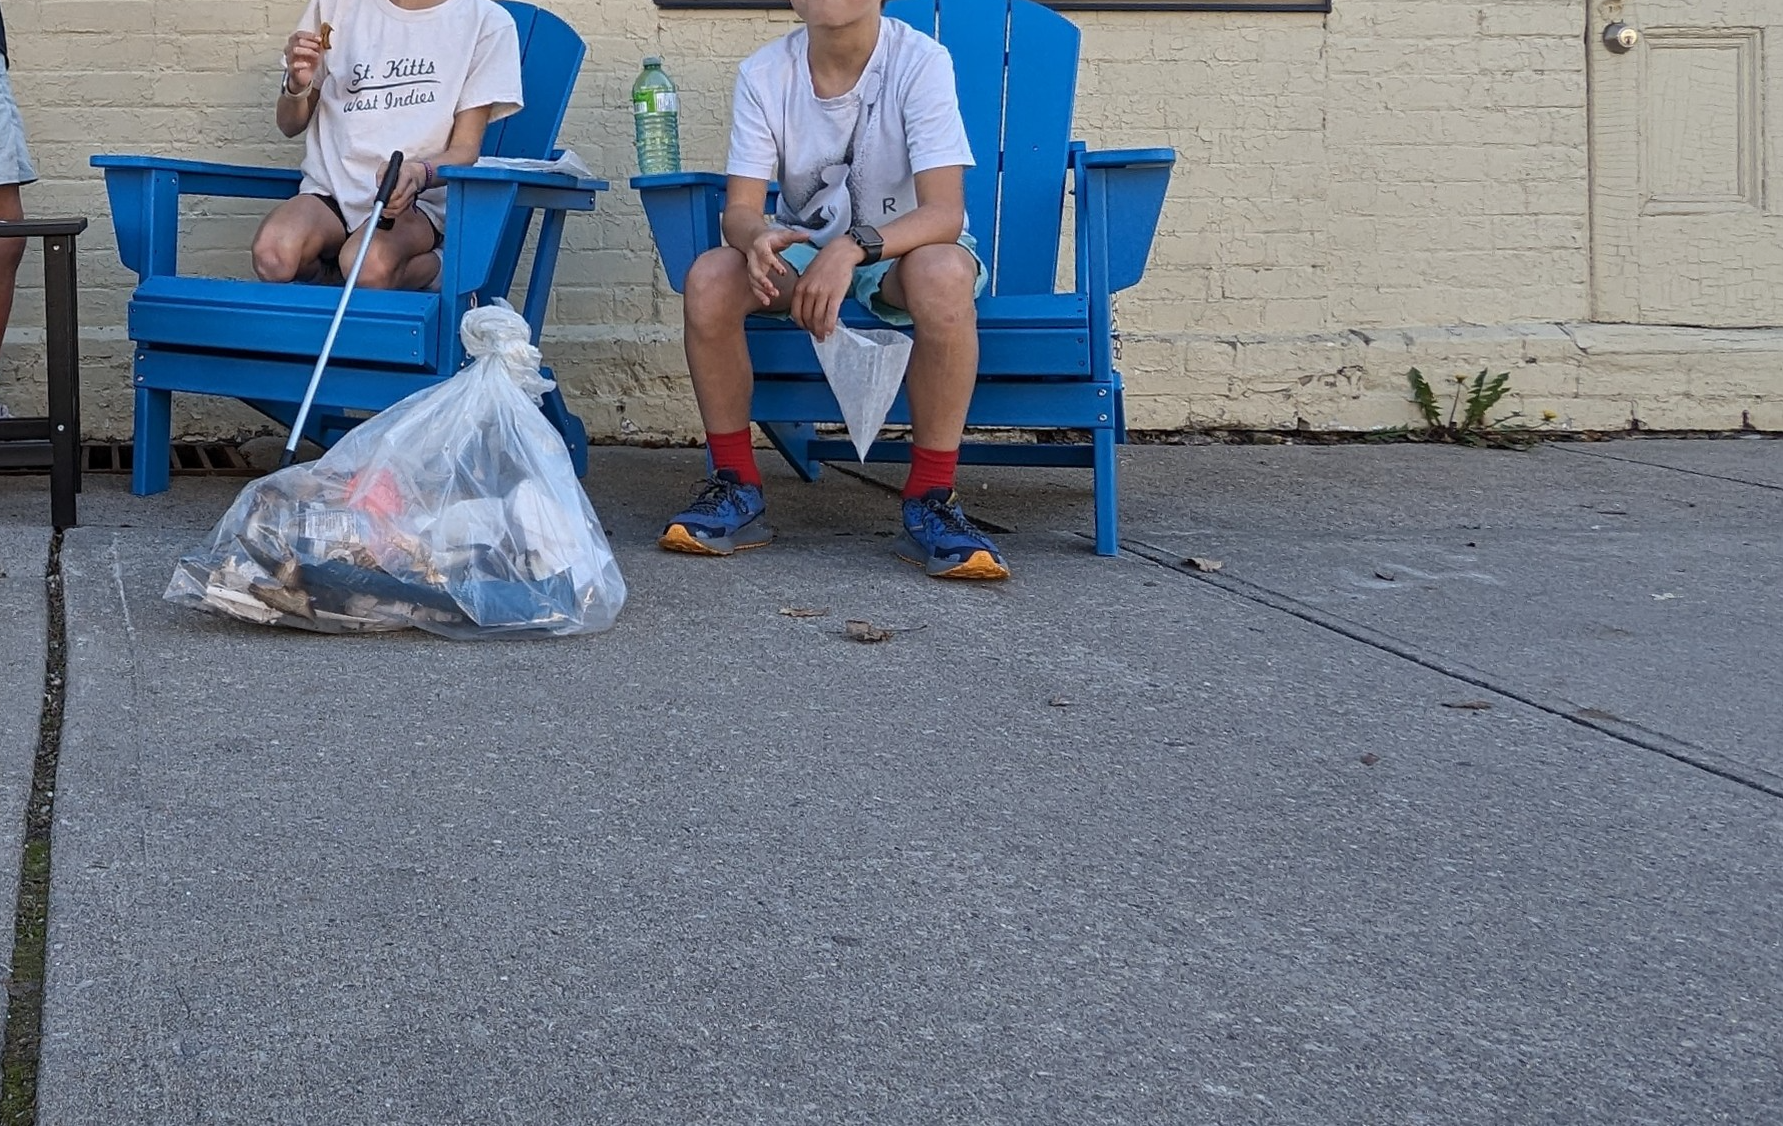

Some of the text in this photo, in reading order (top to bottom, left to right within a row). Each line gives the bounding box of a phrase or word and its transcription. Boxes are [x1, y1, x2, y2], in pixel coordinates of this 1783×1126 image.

[351, 58, 435, 86] St. Kitts
[383, 88, 435, 110] Indies
[882, 197, 897, 215] R
